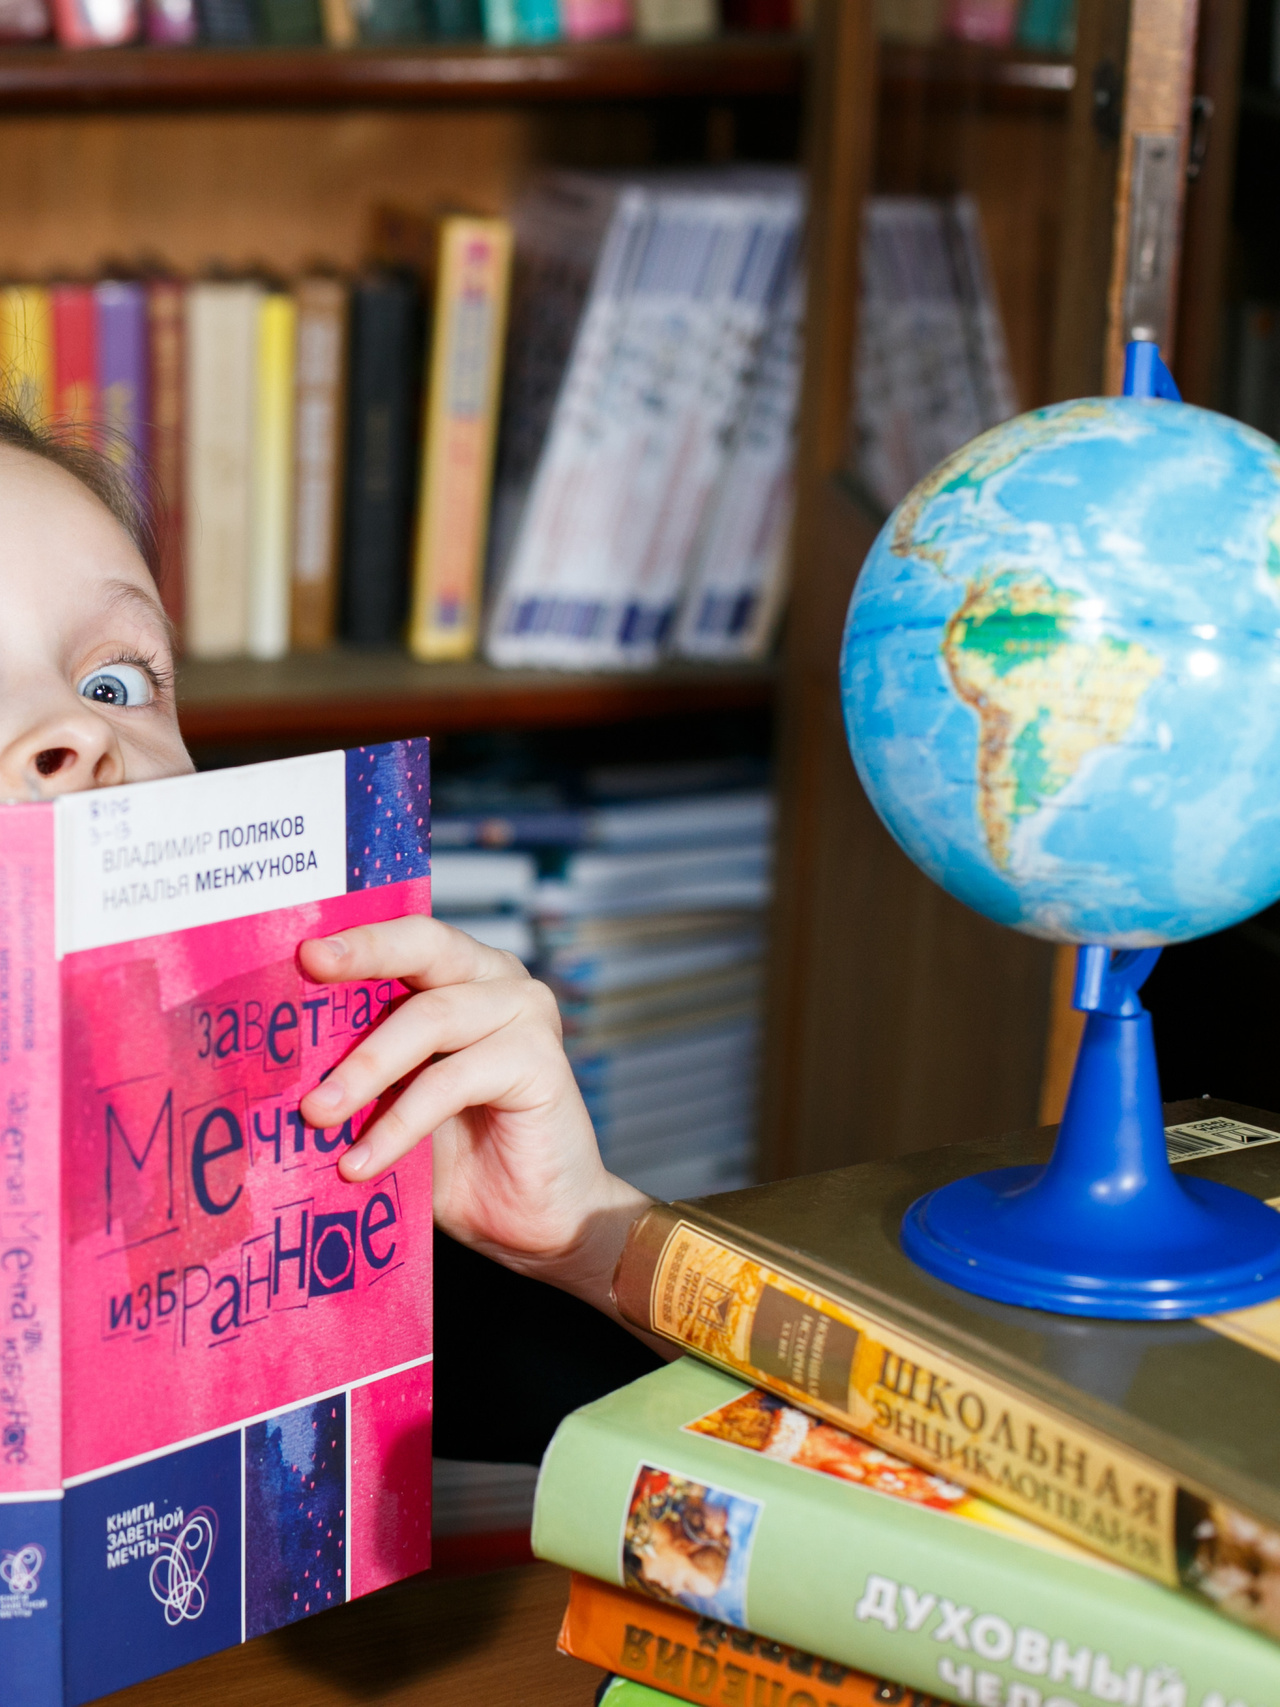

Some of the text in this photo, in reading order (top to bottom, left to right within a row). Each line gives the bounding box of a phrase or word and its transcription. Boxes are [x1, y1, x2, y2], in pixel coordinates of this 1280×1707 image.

[102, 815, 305, 874] ВЛАДИМИР ПОЛЯКОВ
[102, 849, 318, 912] НАТАЛЬЯ МЕНЖУНОВА
[878, 1349, 1160, 1526] ШКОЛЬНАЯ
[873, 1399, 1162, 1566] ЭНЦИКЛОПЕДИЯ
[106, 1501, 155, 1533] КНИГИ
[107, 1506, 184, 1551] ЗАВЕТНОЙ
[107, 1536, 160, 1570] МЕЧТЫ
[856, 1573, 1187, 1707] ДУХОВНЫЙ
[938, 1657, 1078, 1707] ЧЕЛ
